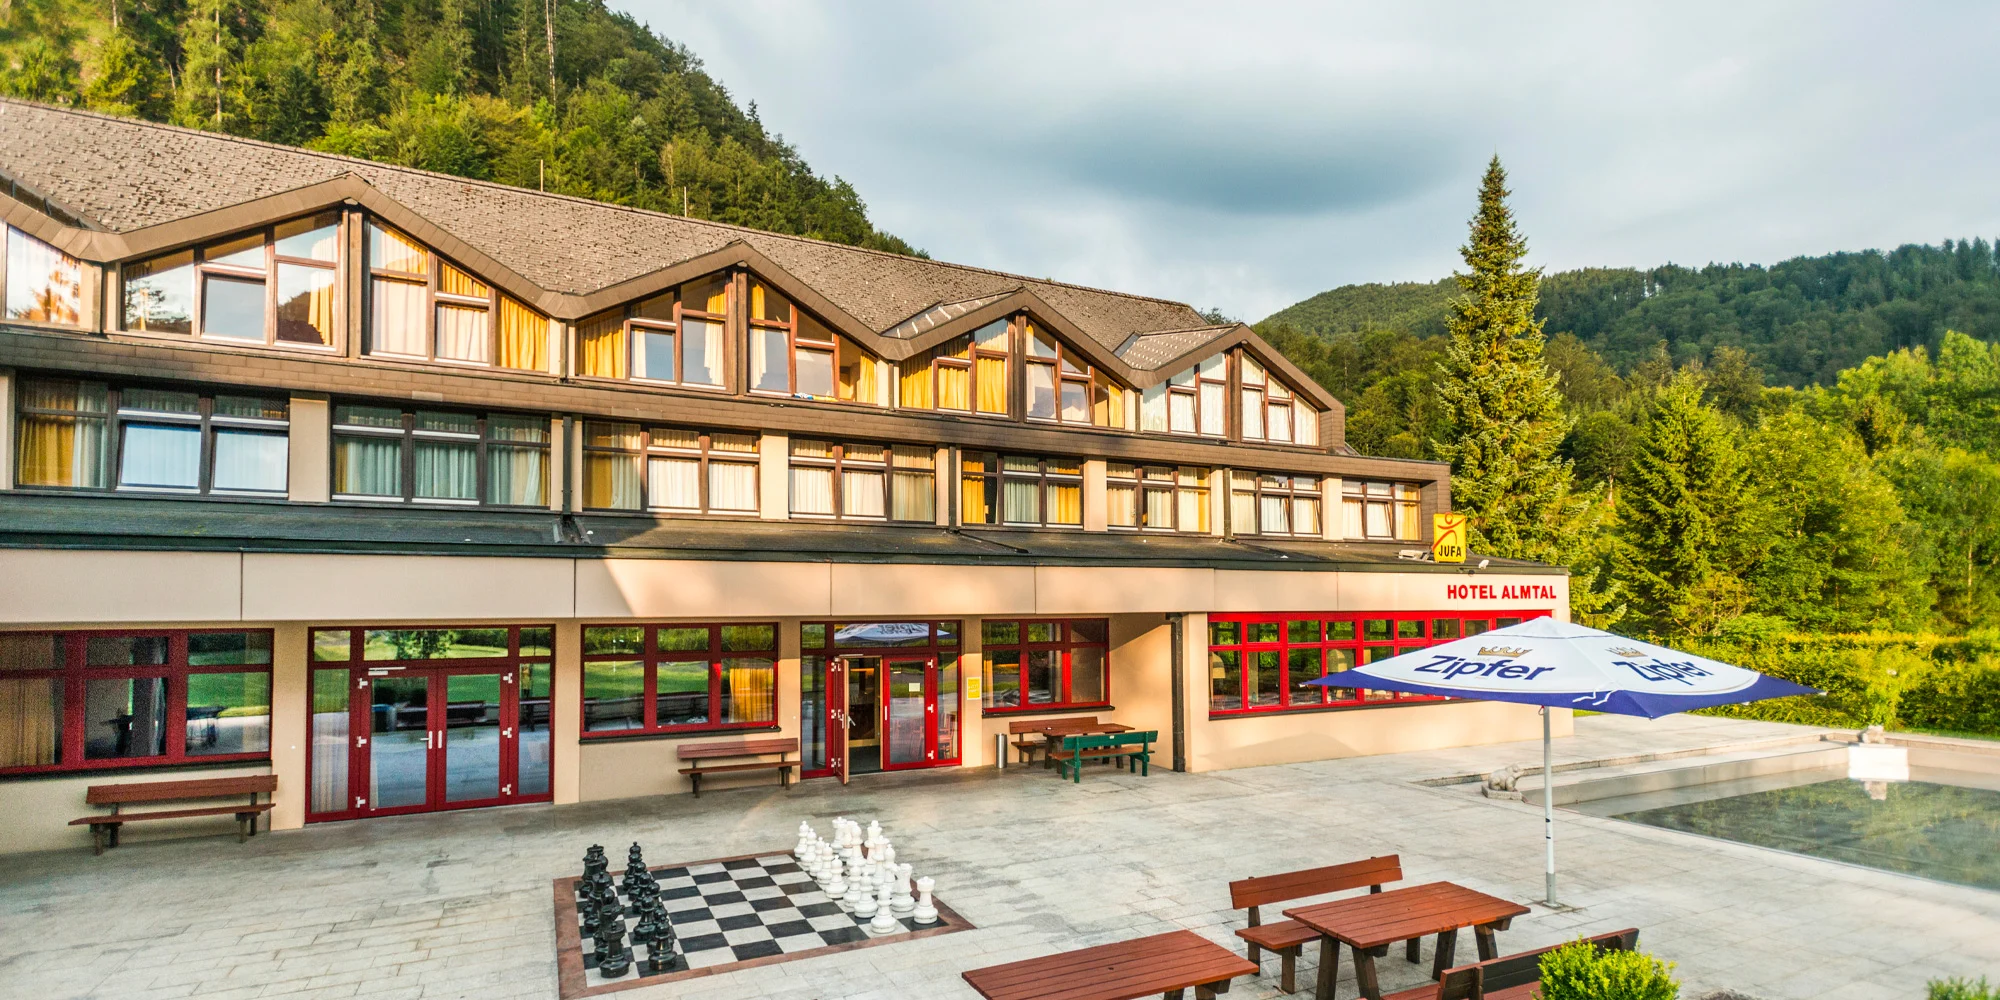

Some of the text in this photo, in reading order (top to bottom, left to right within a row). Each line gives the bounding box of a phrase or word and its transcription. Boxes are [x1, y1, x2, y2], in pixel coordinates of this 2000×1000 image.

[1438, 544, 1462, 557] JUFA
[1447, 584, 1557, 599] HOTEL ALMTAL
[1414, 654, 1556, 681] Zipfer
[1611, 658, 1714, 686] Zipfer
